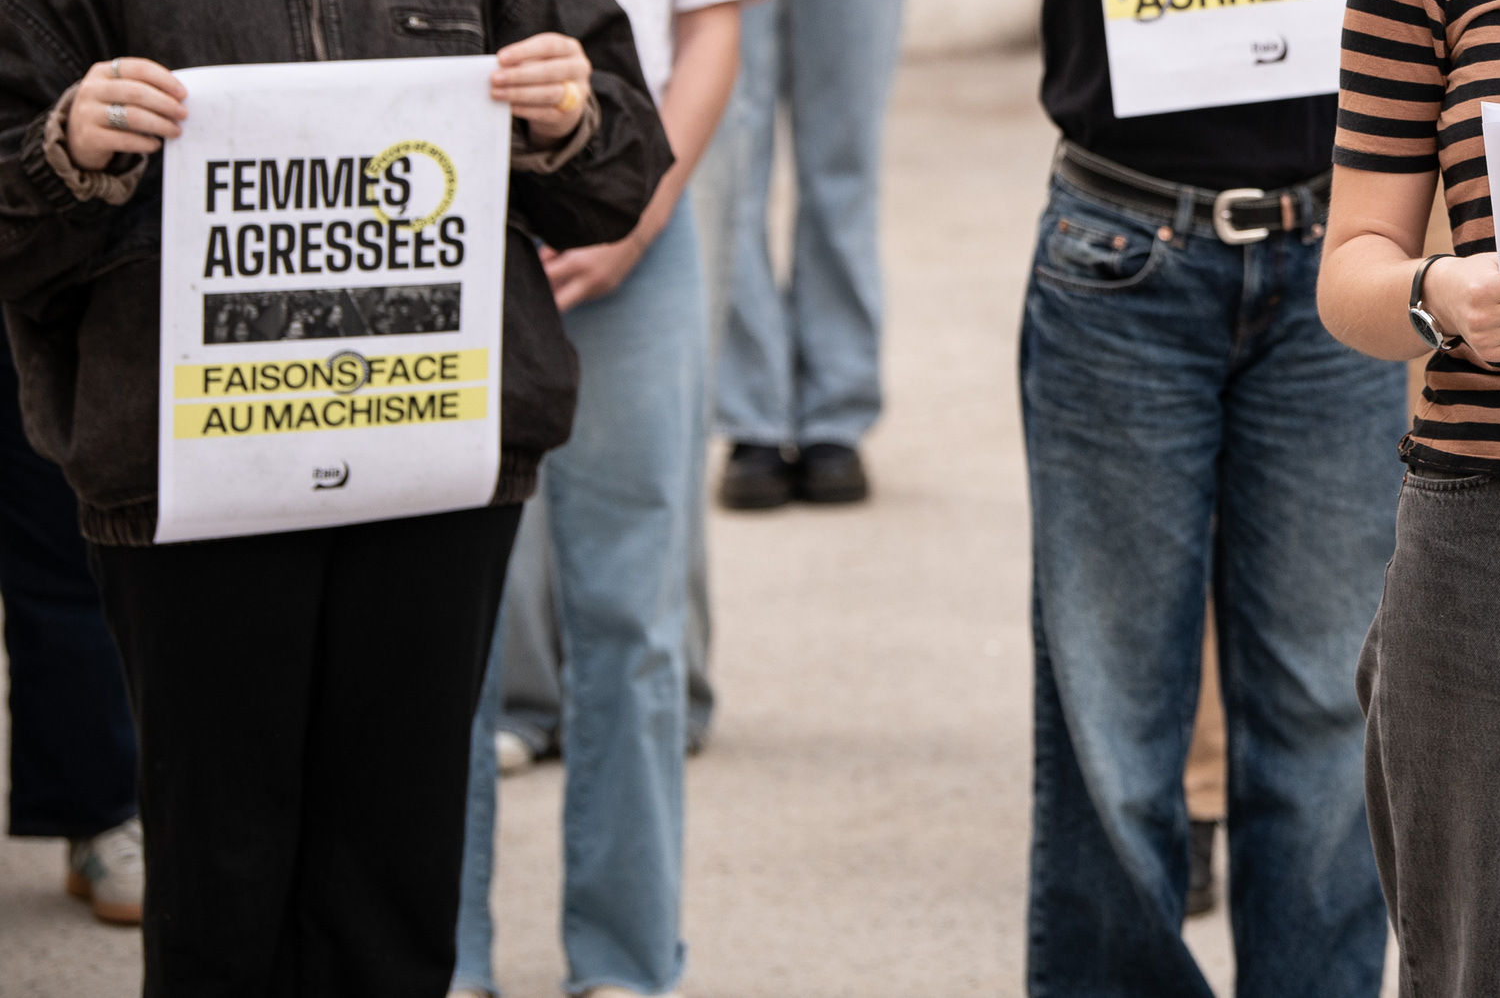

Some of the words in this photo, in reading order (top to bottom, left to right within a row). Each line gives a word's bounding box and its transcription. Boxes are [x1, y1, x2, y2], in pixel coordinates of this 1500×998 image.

[205, 157, 411, 212] FEMMES
[202, 358, 359, 395] FAISONS
[367, 353, 460, 384] FACE
[203, 406, 254, 435] AU
[264, 392, 460, 432] MACHISME
